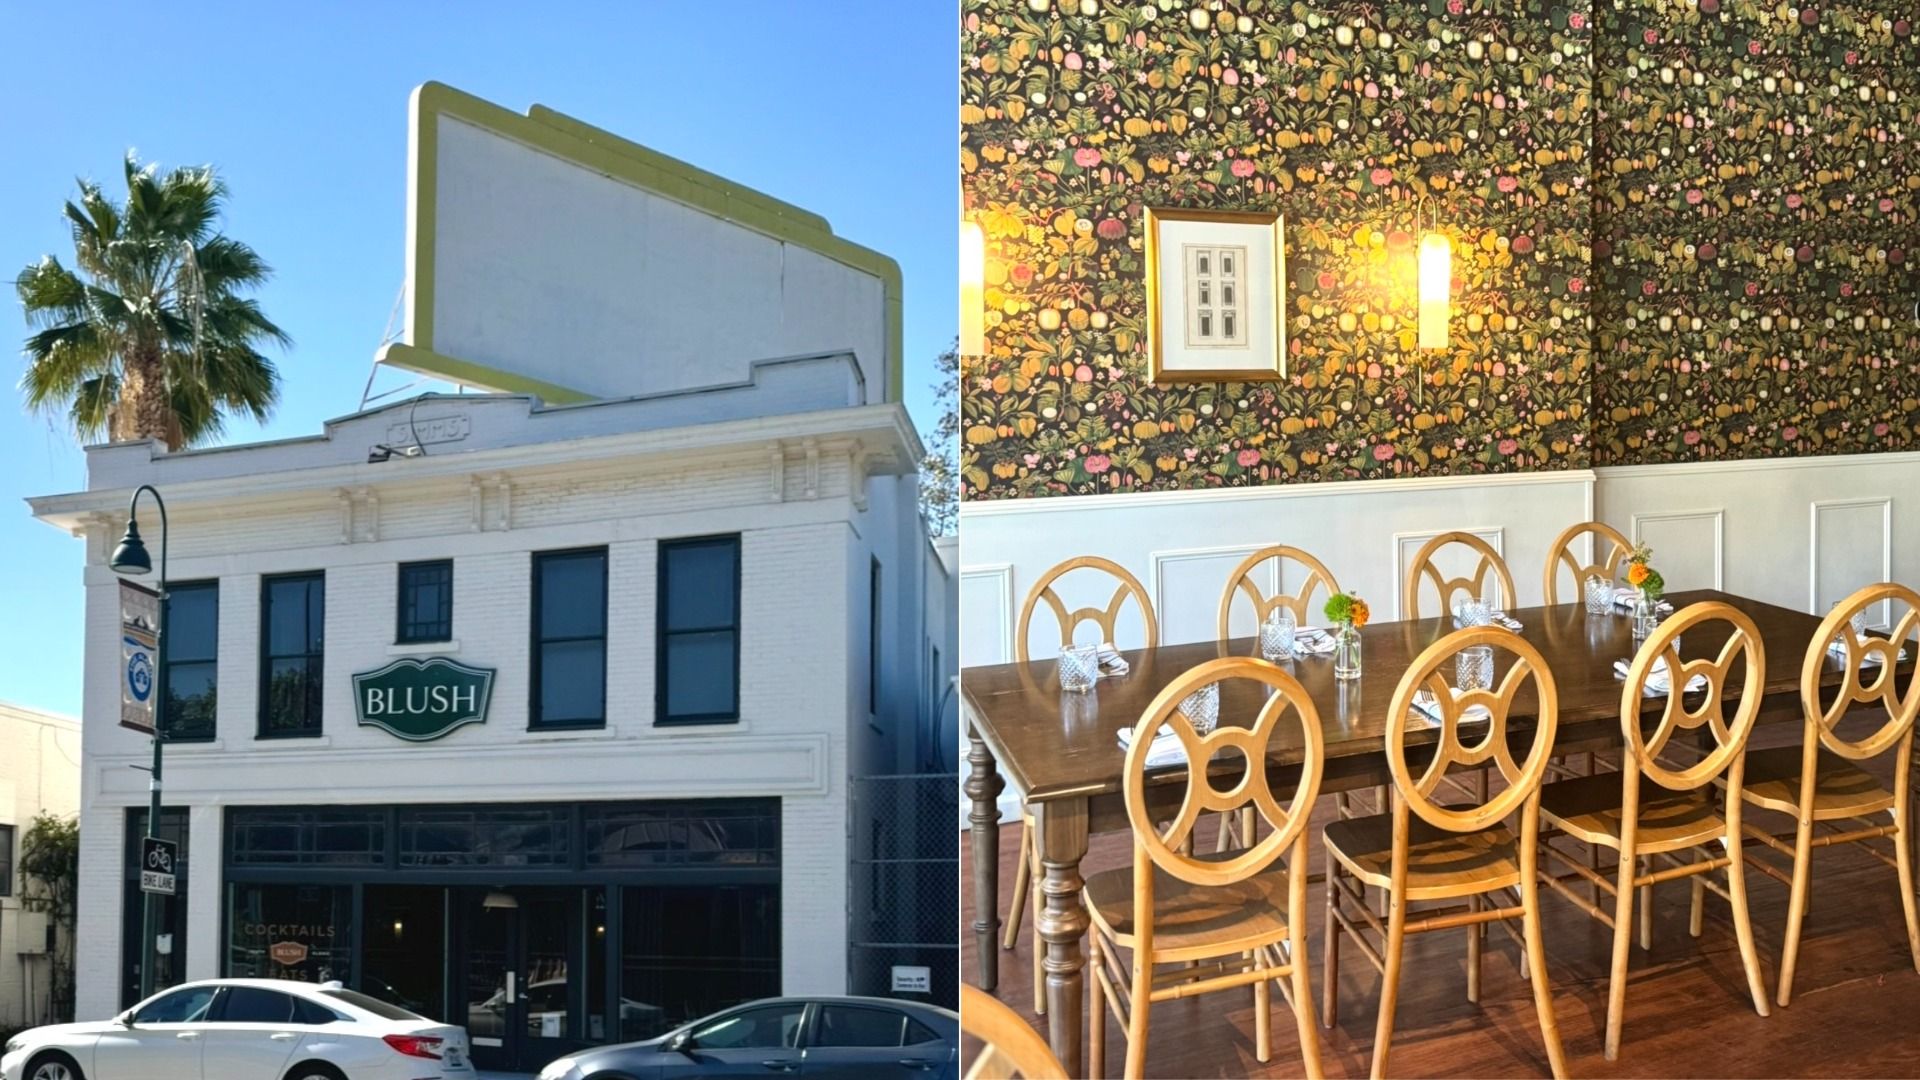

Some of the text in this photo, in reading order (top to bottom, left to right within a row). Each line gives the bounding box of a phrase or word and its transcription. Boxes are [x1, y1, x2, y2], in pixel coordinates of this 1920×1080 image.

[367, 685, 476, 714] BLUSH
[144, 873, 173, 890] BIKE LANE
[244, 923, 336, 937] COCKTAILS
